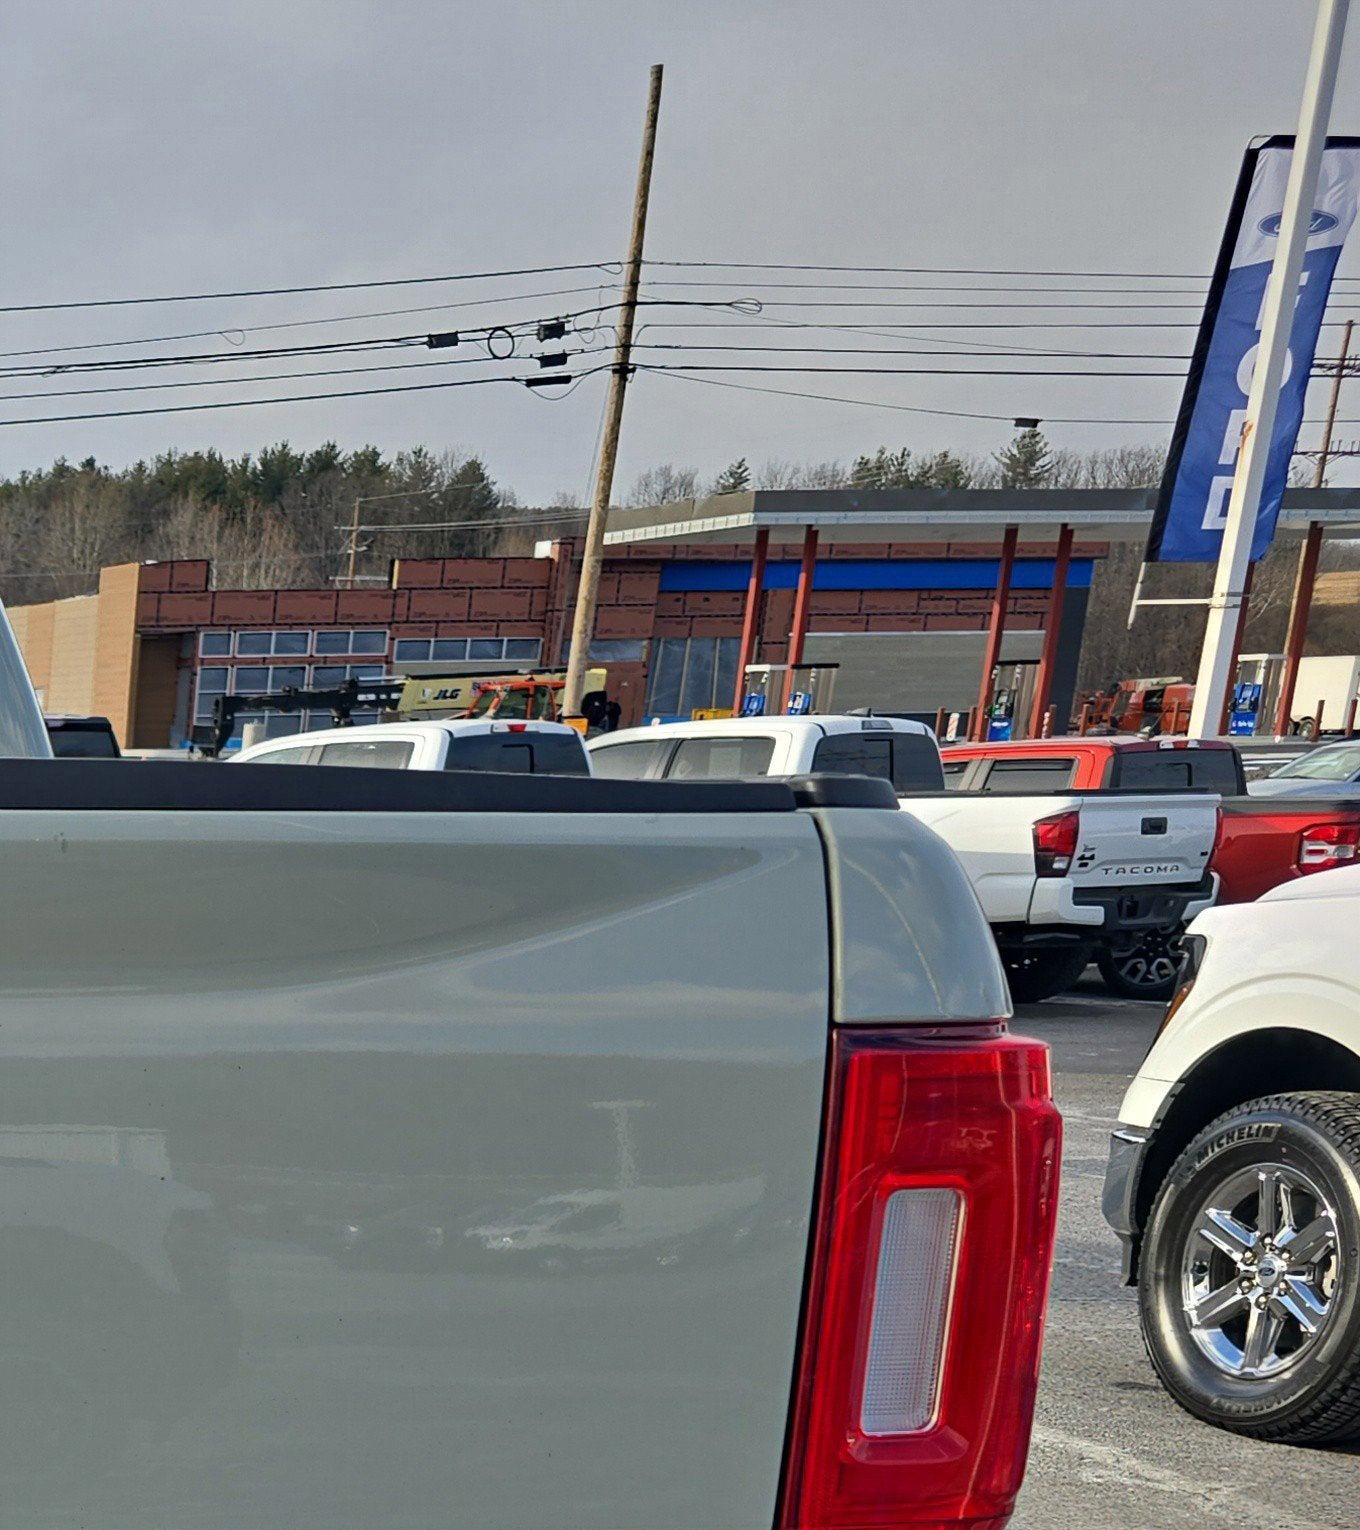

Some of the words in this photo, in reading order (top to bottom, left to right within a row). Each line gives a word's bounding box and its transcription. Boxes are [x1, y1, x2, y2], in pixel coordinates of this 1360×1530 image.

[433, 688, 462, 701] JLG
[1101, 864, 1180, 876] TACOMA
[1195, 1124, 1276, 1164] MICHELIN
